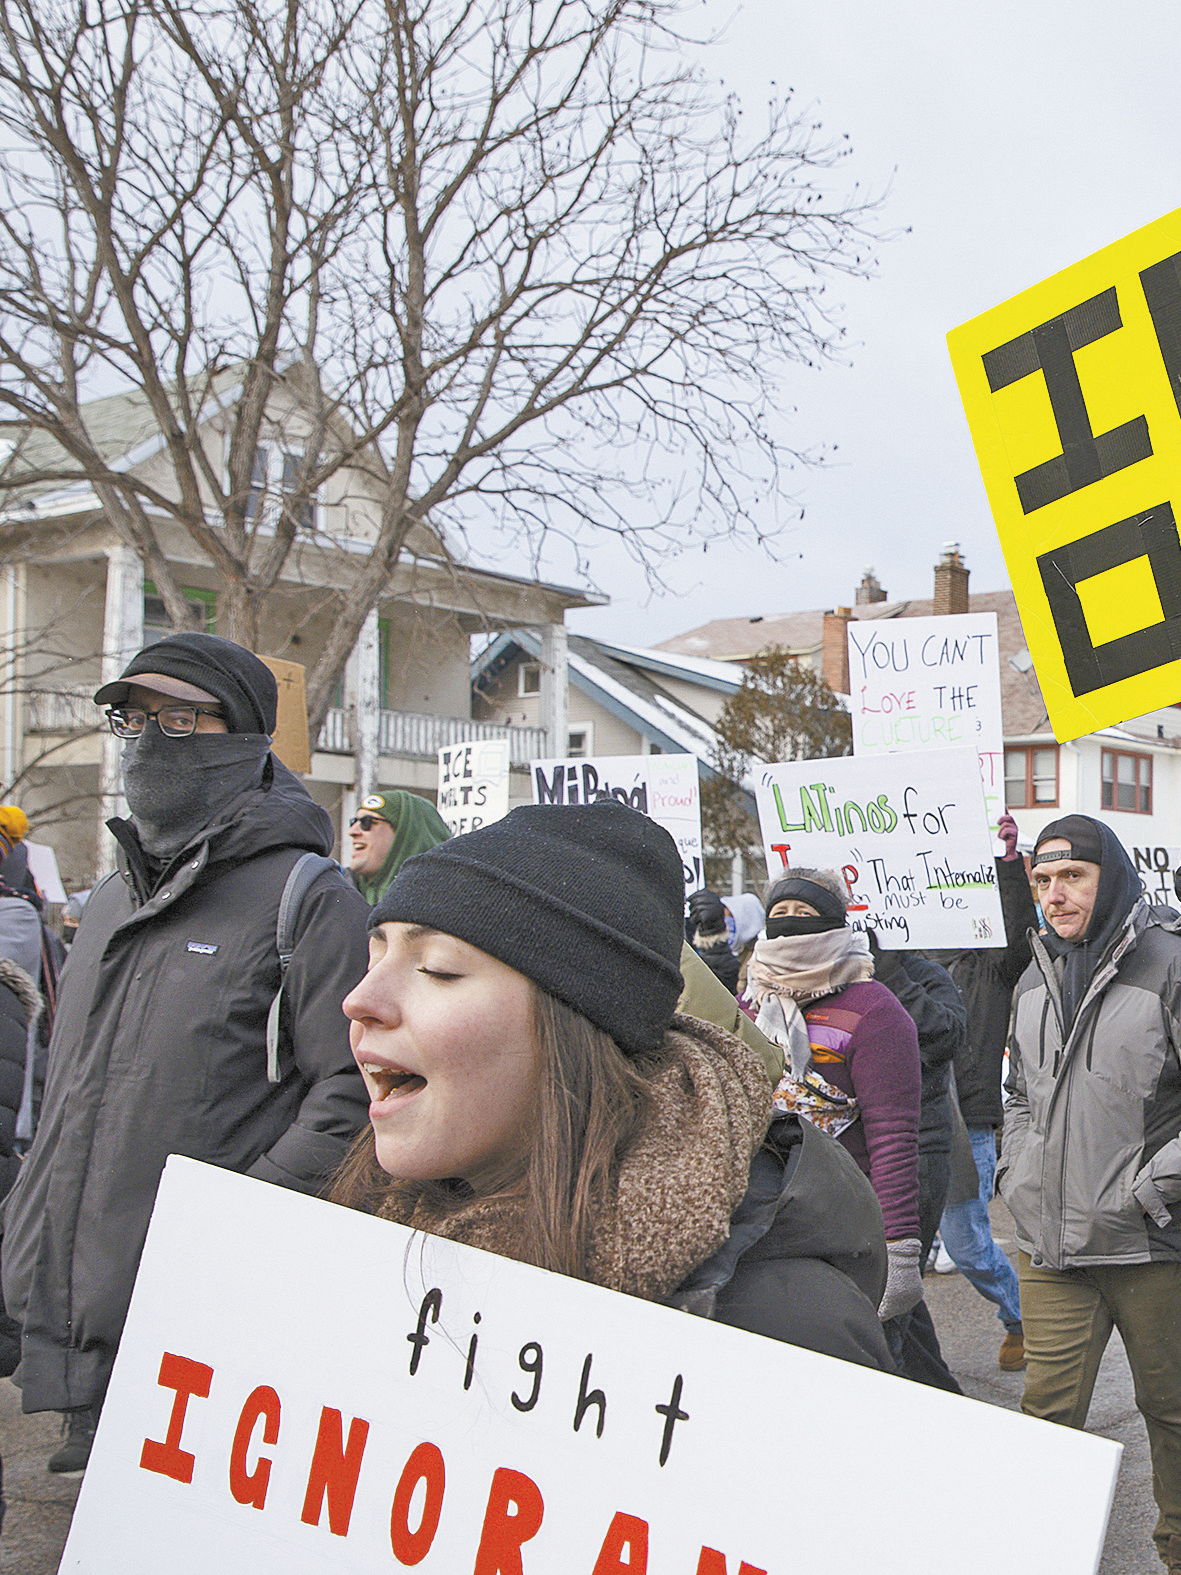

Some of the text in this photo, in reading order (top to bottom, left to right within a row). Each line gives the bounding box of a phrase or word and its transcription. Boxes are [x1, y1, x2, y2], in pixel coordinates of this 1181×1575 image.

[850, 631, 992, 679] YOU CAN'T
[861, 685, 978, 714] LOVE THE
[861, 715, 962, 747] CULTURE
[443, 747, 472, 783] ICE
[903, 786, 956, 834] for
[867, 859, 915, 894] That
[1133, 848, 1169, 872] NO
[940, 892, 969, 910] be
[407, 1287, 690, 1467] fight
[139, 1351, 768, 1575] IGNORA
